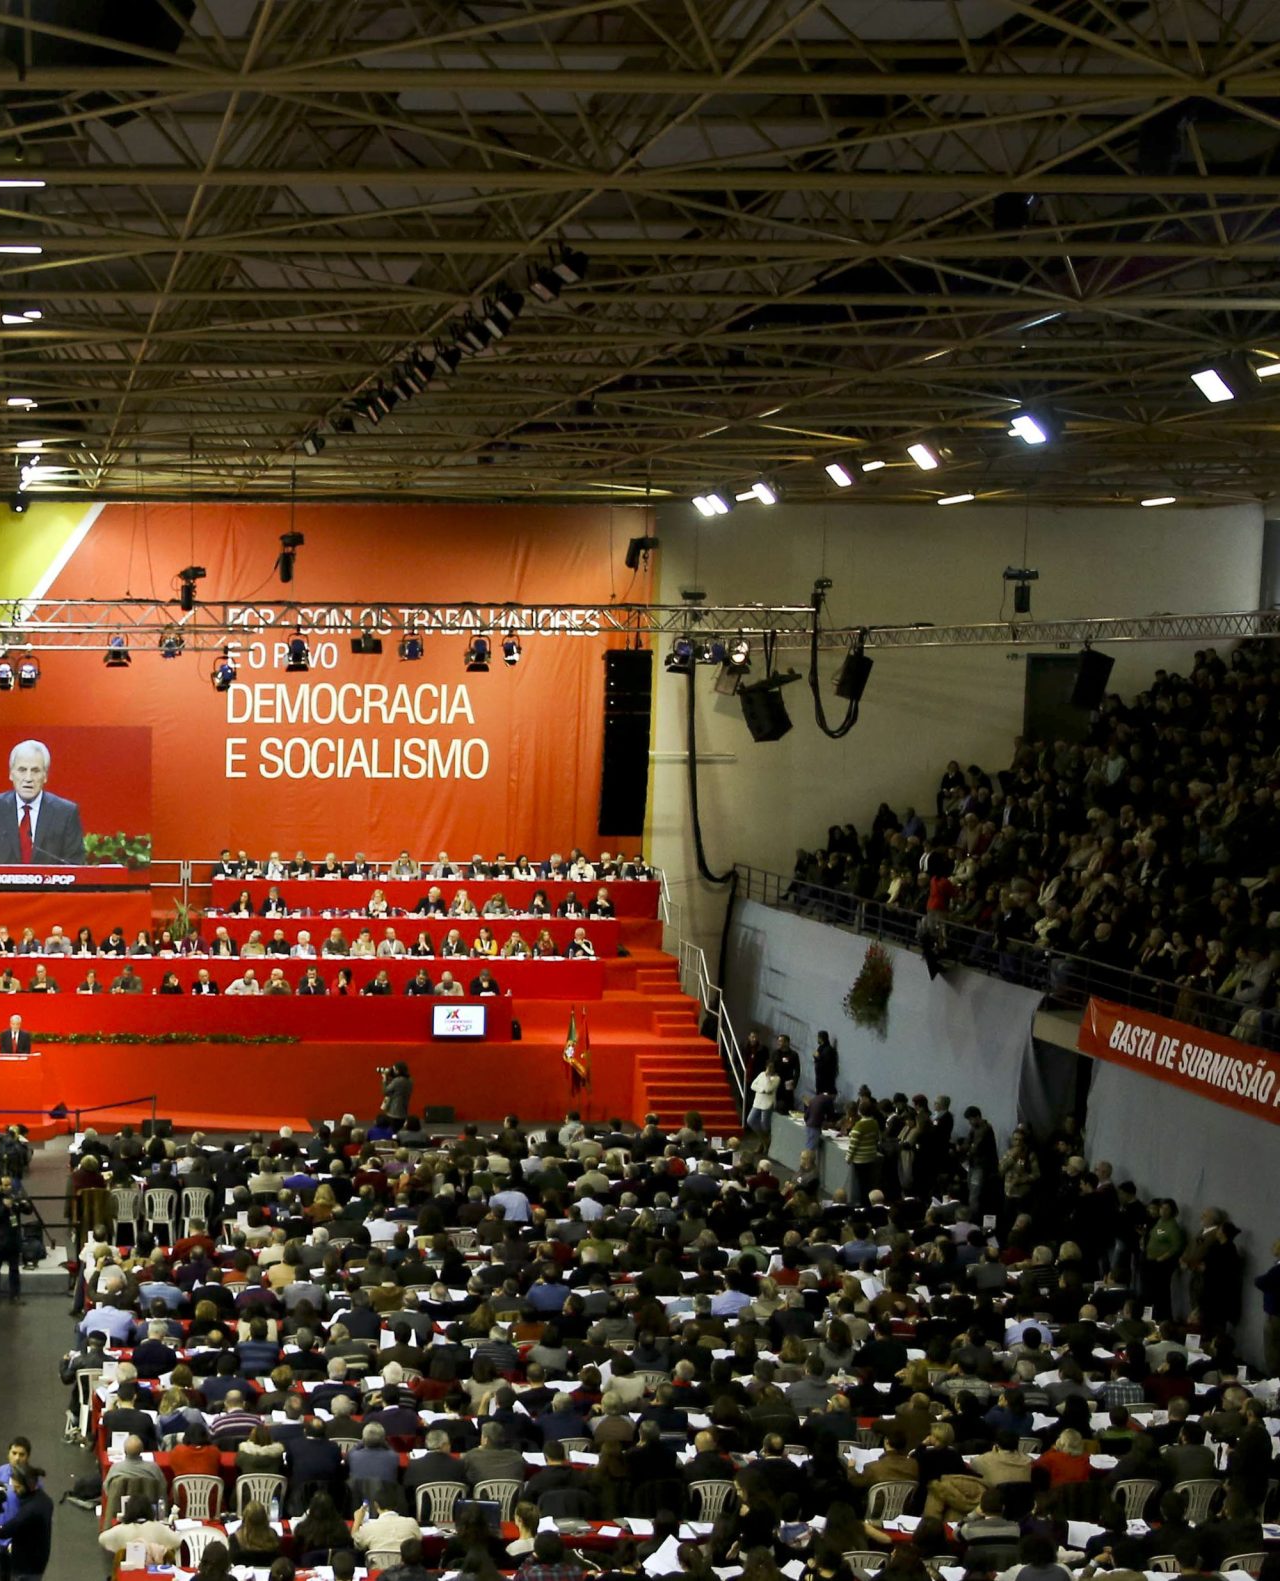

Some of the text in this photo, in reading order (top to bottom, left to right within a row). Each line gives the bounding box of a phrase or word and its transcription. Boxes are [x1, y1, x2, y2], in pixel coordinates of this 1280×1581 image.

[227, 608, 275, 634] PCP
[297, 608, 352, 635] COM
[359, 608, 393, 635] OS
[395, 609, 600, 636] TRABALHADORES
[227, 642, 338, 669] E O PVO
[226, 683, 475, 724] DEMOCRACIA
[225, 737, 490, 779] E SOCIALISMO
[52, 874, 75, 884] PCP
[1109, 1021, 1156, 1061] BASTA
[1156, 1035, 1180, 1070] DE
[1178, 1043, 1275, 1103] SUBMISSÃO
